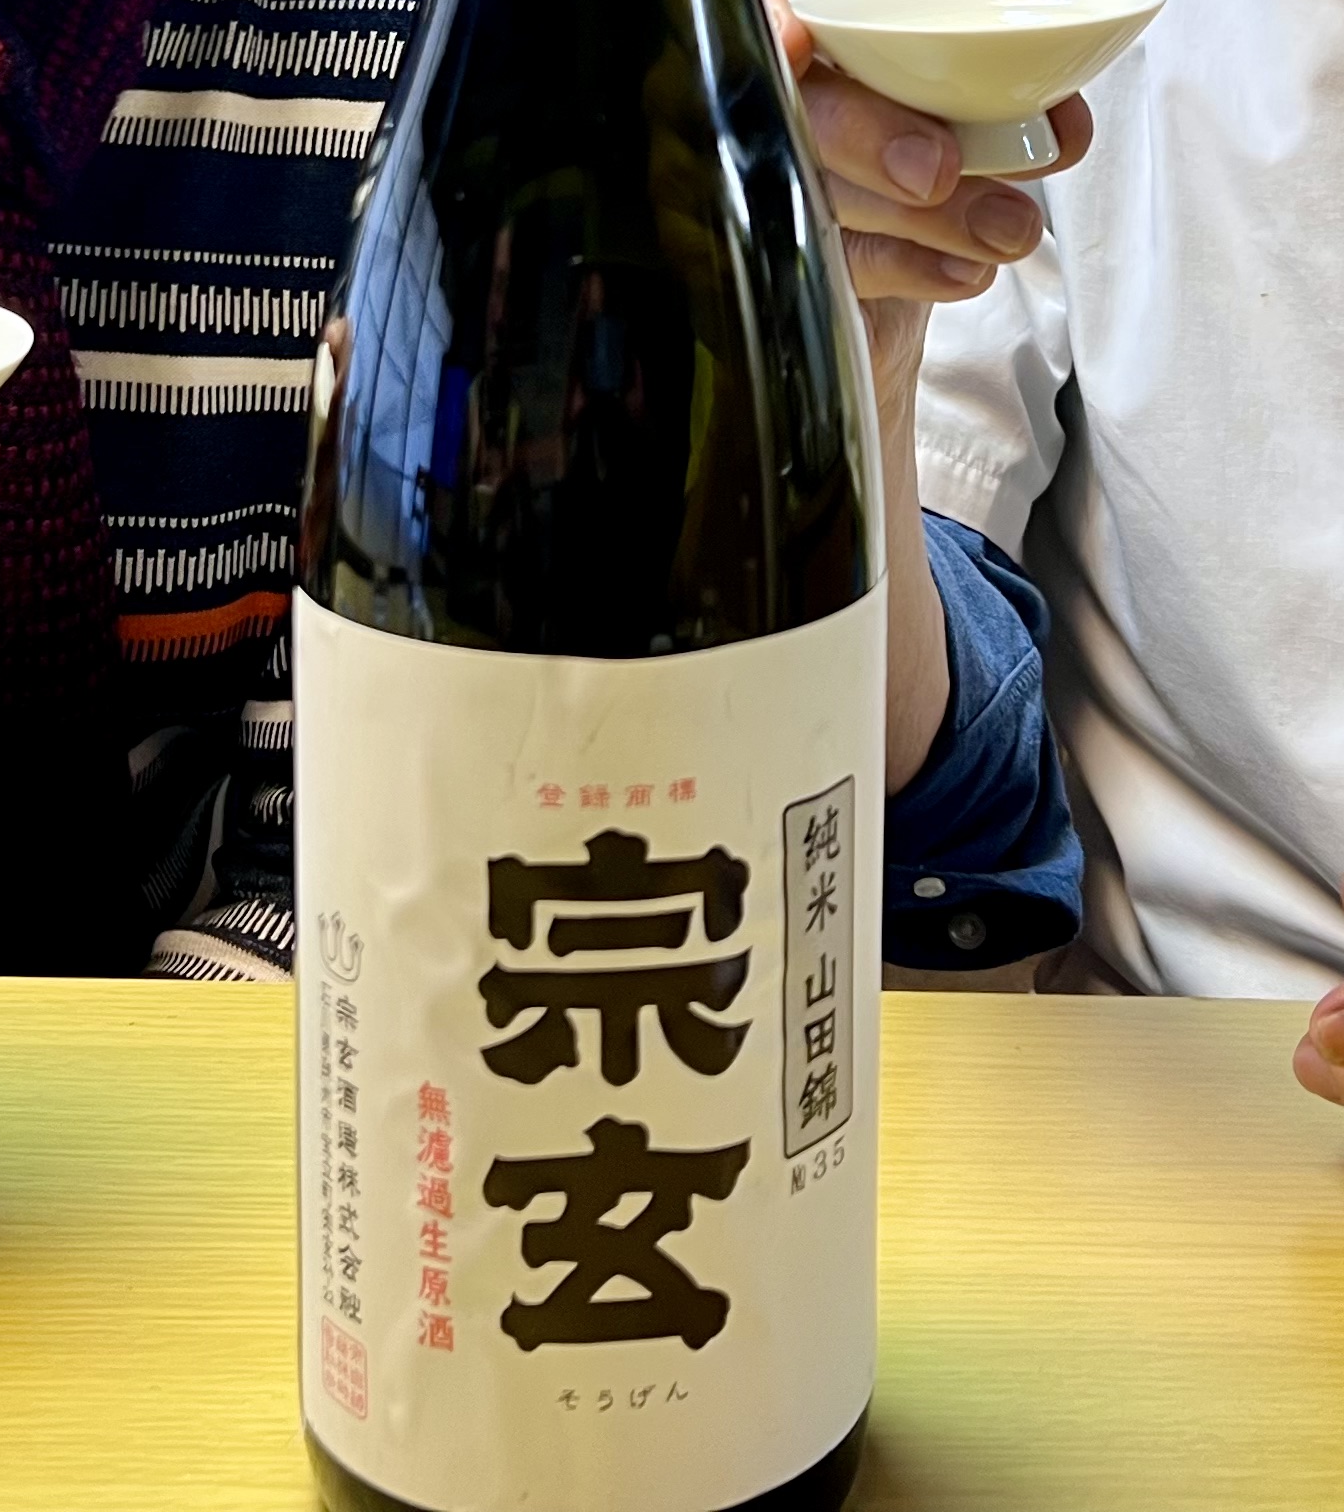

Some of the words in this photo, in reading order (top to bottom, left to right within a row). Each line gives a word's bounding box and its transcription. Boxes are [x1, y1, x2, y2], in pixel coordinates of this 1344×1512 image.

[416, 1080, 454, 1353] 無濾過生原酒
[478, 829, 753, 1353] 宗玄
[555, 1380, 690, 1412] そうげん
